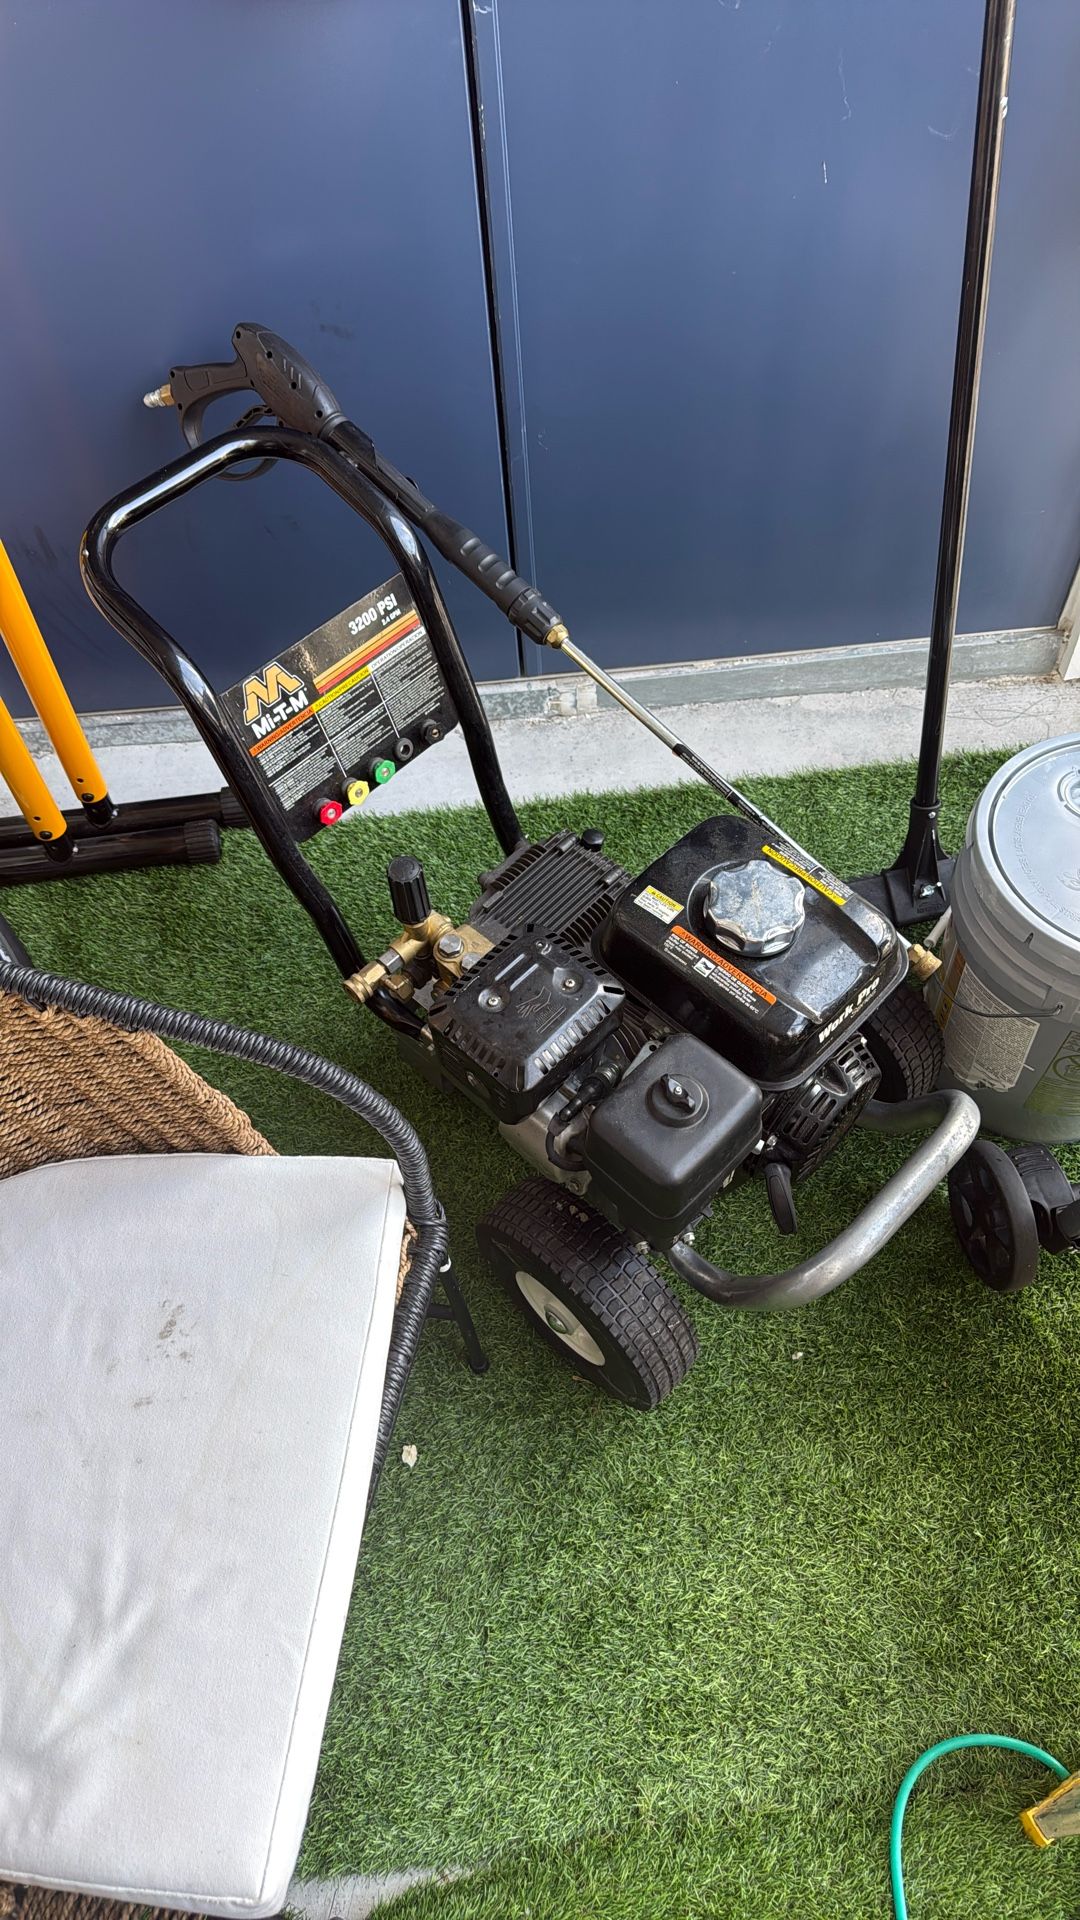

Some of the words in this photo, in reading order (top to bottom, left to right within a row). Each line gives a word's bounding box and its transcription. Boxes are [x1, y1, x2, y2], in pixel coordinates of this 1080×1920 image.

[348, 607, 378, 635] 3200
[377, 593, 398, 616] PSI
[381, 616, 391, 626] 2.4
[389, 608, 402, 620] GPM
[251, 689, 309, 740] Mi-T-M
[656, 893, 677, 908] CAUTION
[684, 934, 768, 999] WARNING/ADVERTENCIA
[818, 1003, 854, 1044] Work
[857, 977, 880, 1006] Pro
